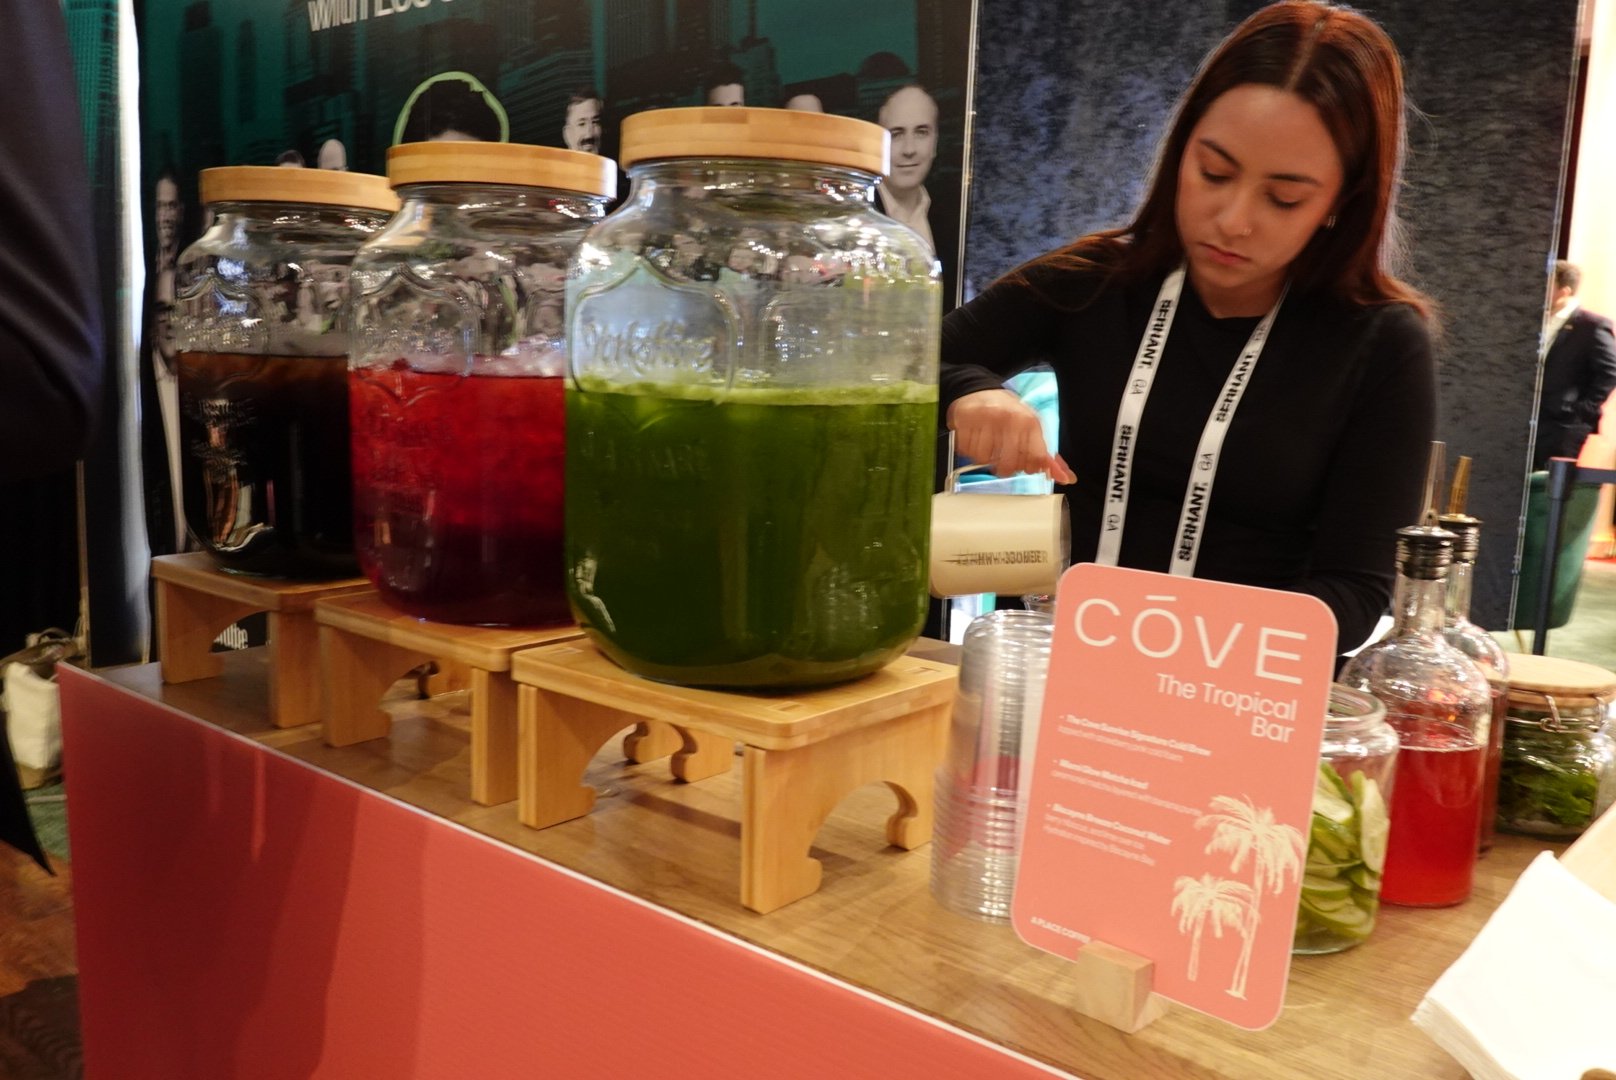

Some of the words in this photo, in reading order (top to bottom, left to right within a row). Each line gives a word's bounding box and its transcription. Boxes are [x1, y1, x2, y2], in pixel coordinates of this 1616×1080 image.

[1156, 673, 1197, 700] The
[1202, 682, 1298, 721] Tropical
[1250, 716, 1295, 743] Bar
